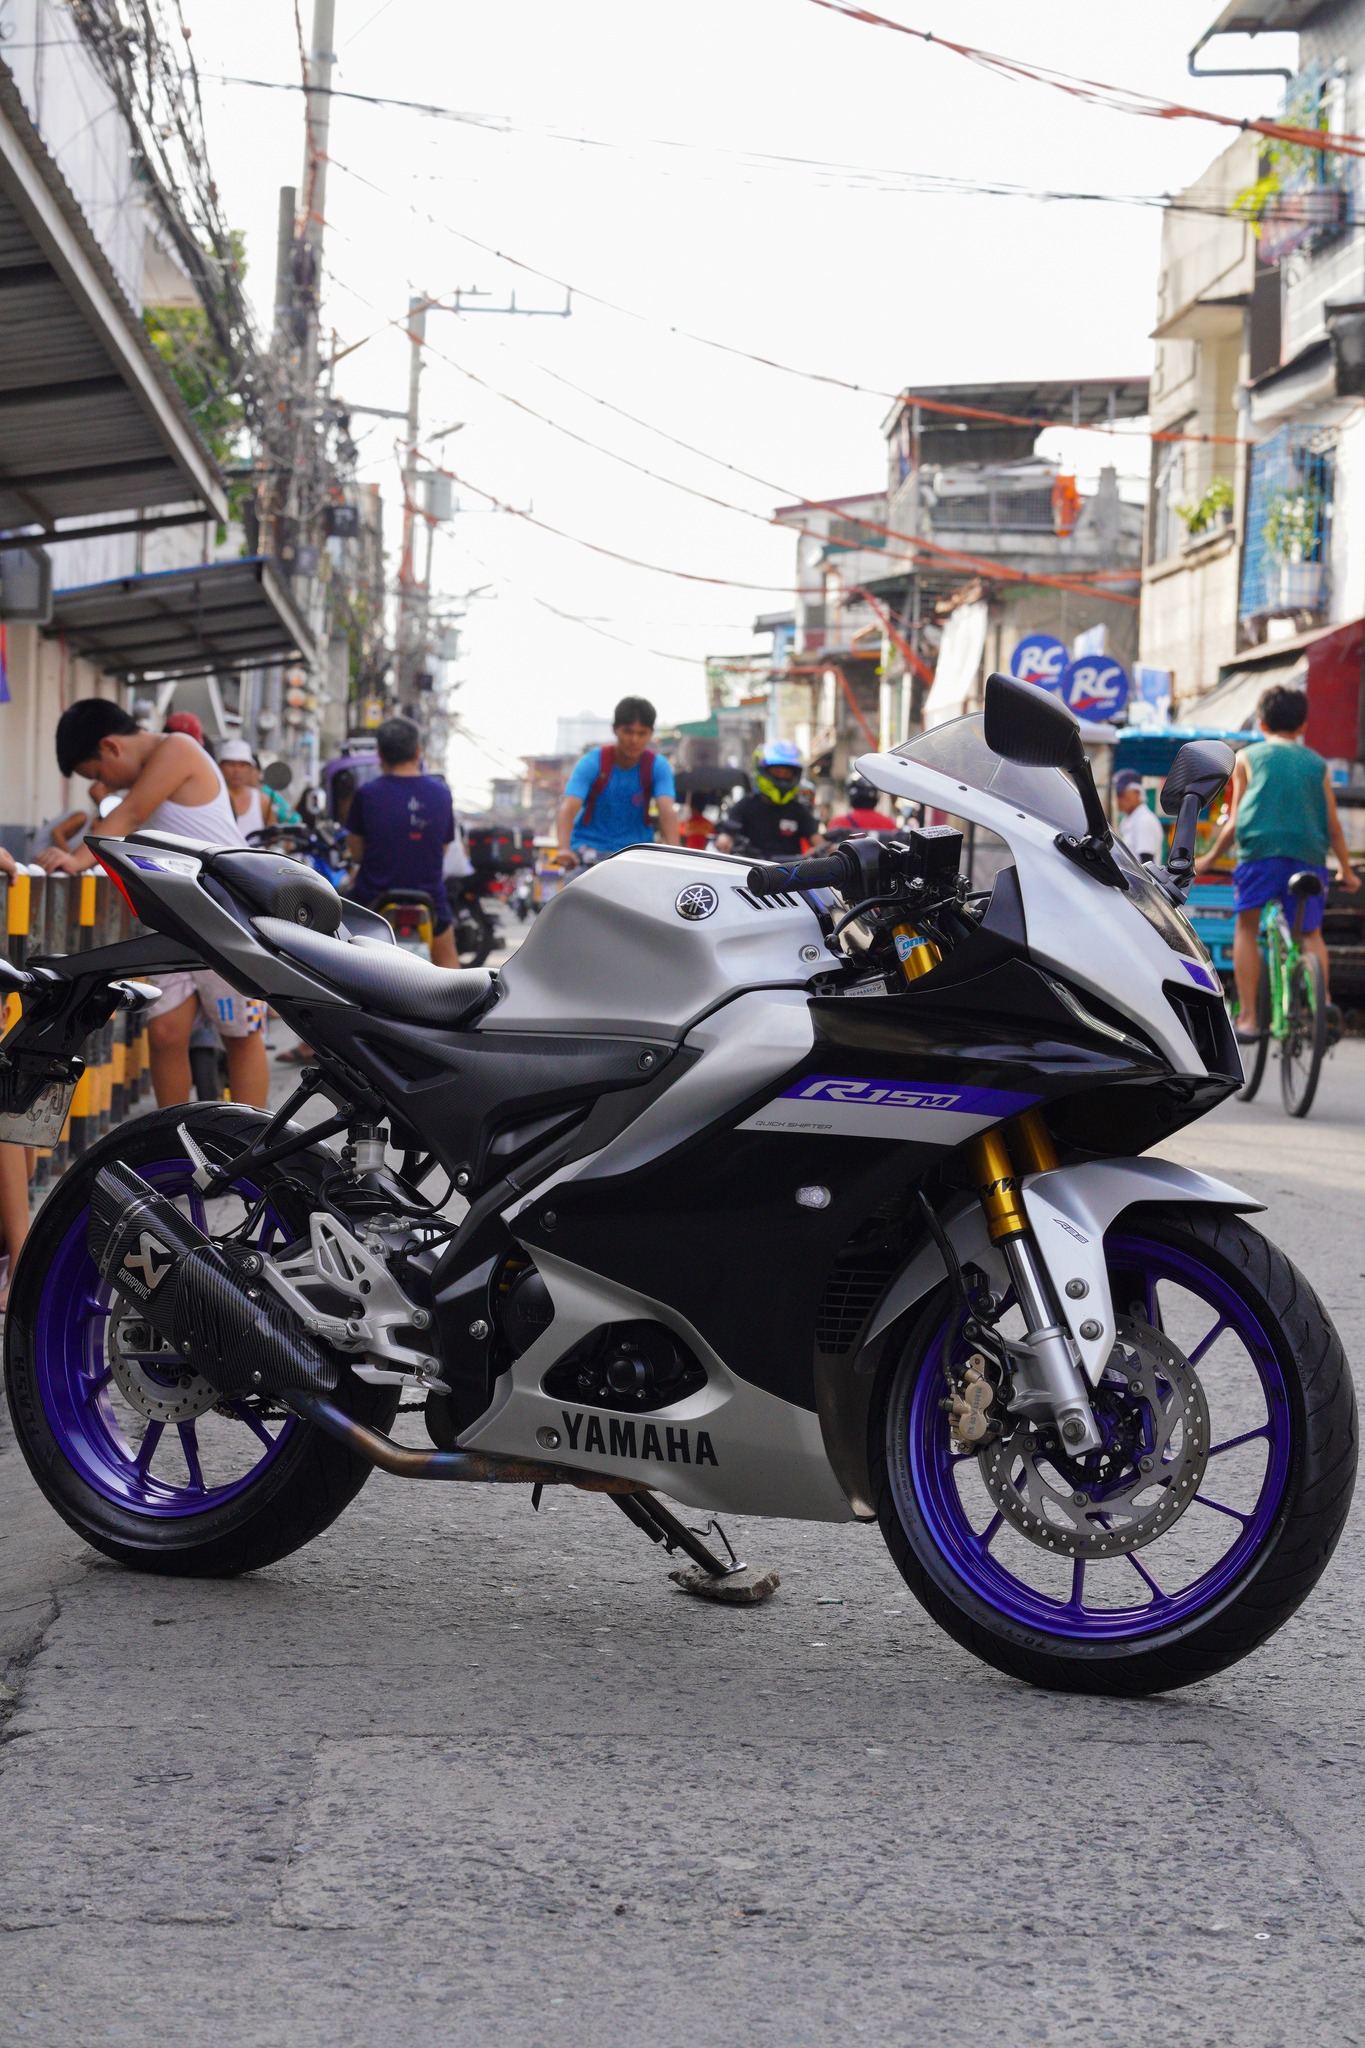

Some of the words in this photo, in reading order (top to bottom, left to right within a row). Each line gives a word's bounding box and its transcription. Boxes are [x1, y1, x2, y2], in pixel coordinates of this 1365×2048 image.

[1017, 646, 1064, 681] RC
[1068, 666, 1121, 706] RC
[217, 998, 234, 1021] 11
[800, 1080, 961, 1108] R15M
[787, 1122, 833, 1130] SHIFTER
[1053, 1218, 1089, 1244] ABS
[562, 1411, 719, 1466] YAMAHA
